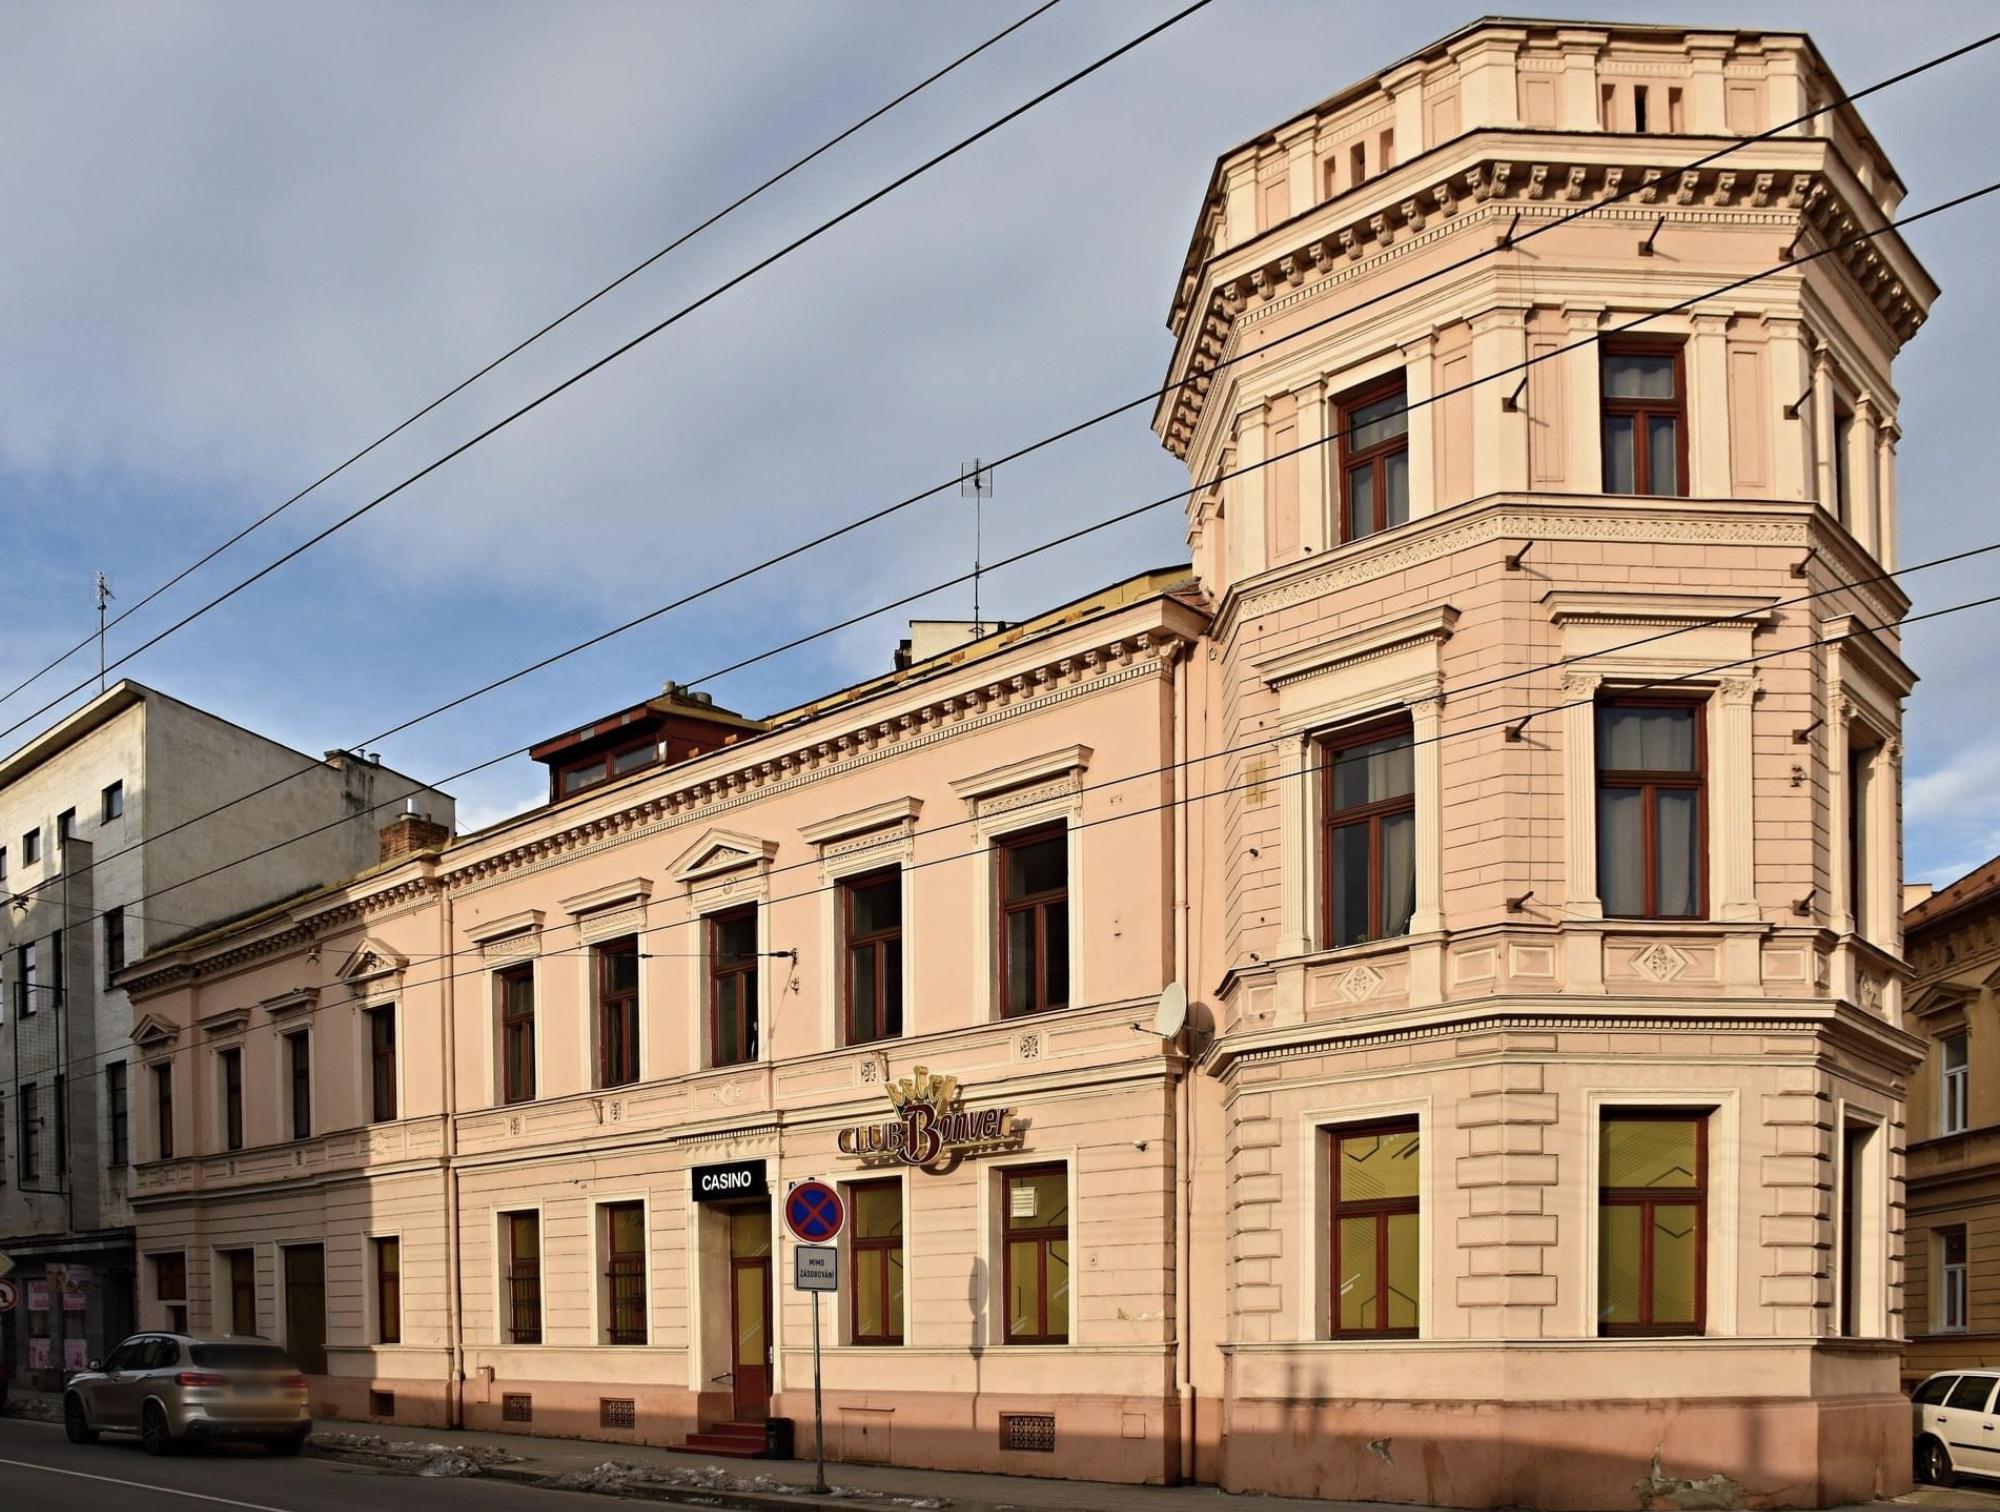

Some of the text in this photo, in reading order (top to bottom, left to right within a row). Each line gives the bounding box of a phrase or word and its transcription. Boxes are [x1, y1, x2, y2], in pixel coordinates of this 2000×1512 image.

[838, 1103, 1012, 1166] CLUB Bonver
[701, 1171, 752, 1191] CASINO
[809, 1258, 825, 1267] MIMO
